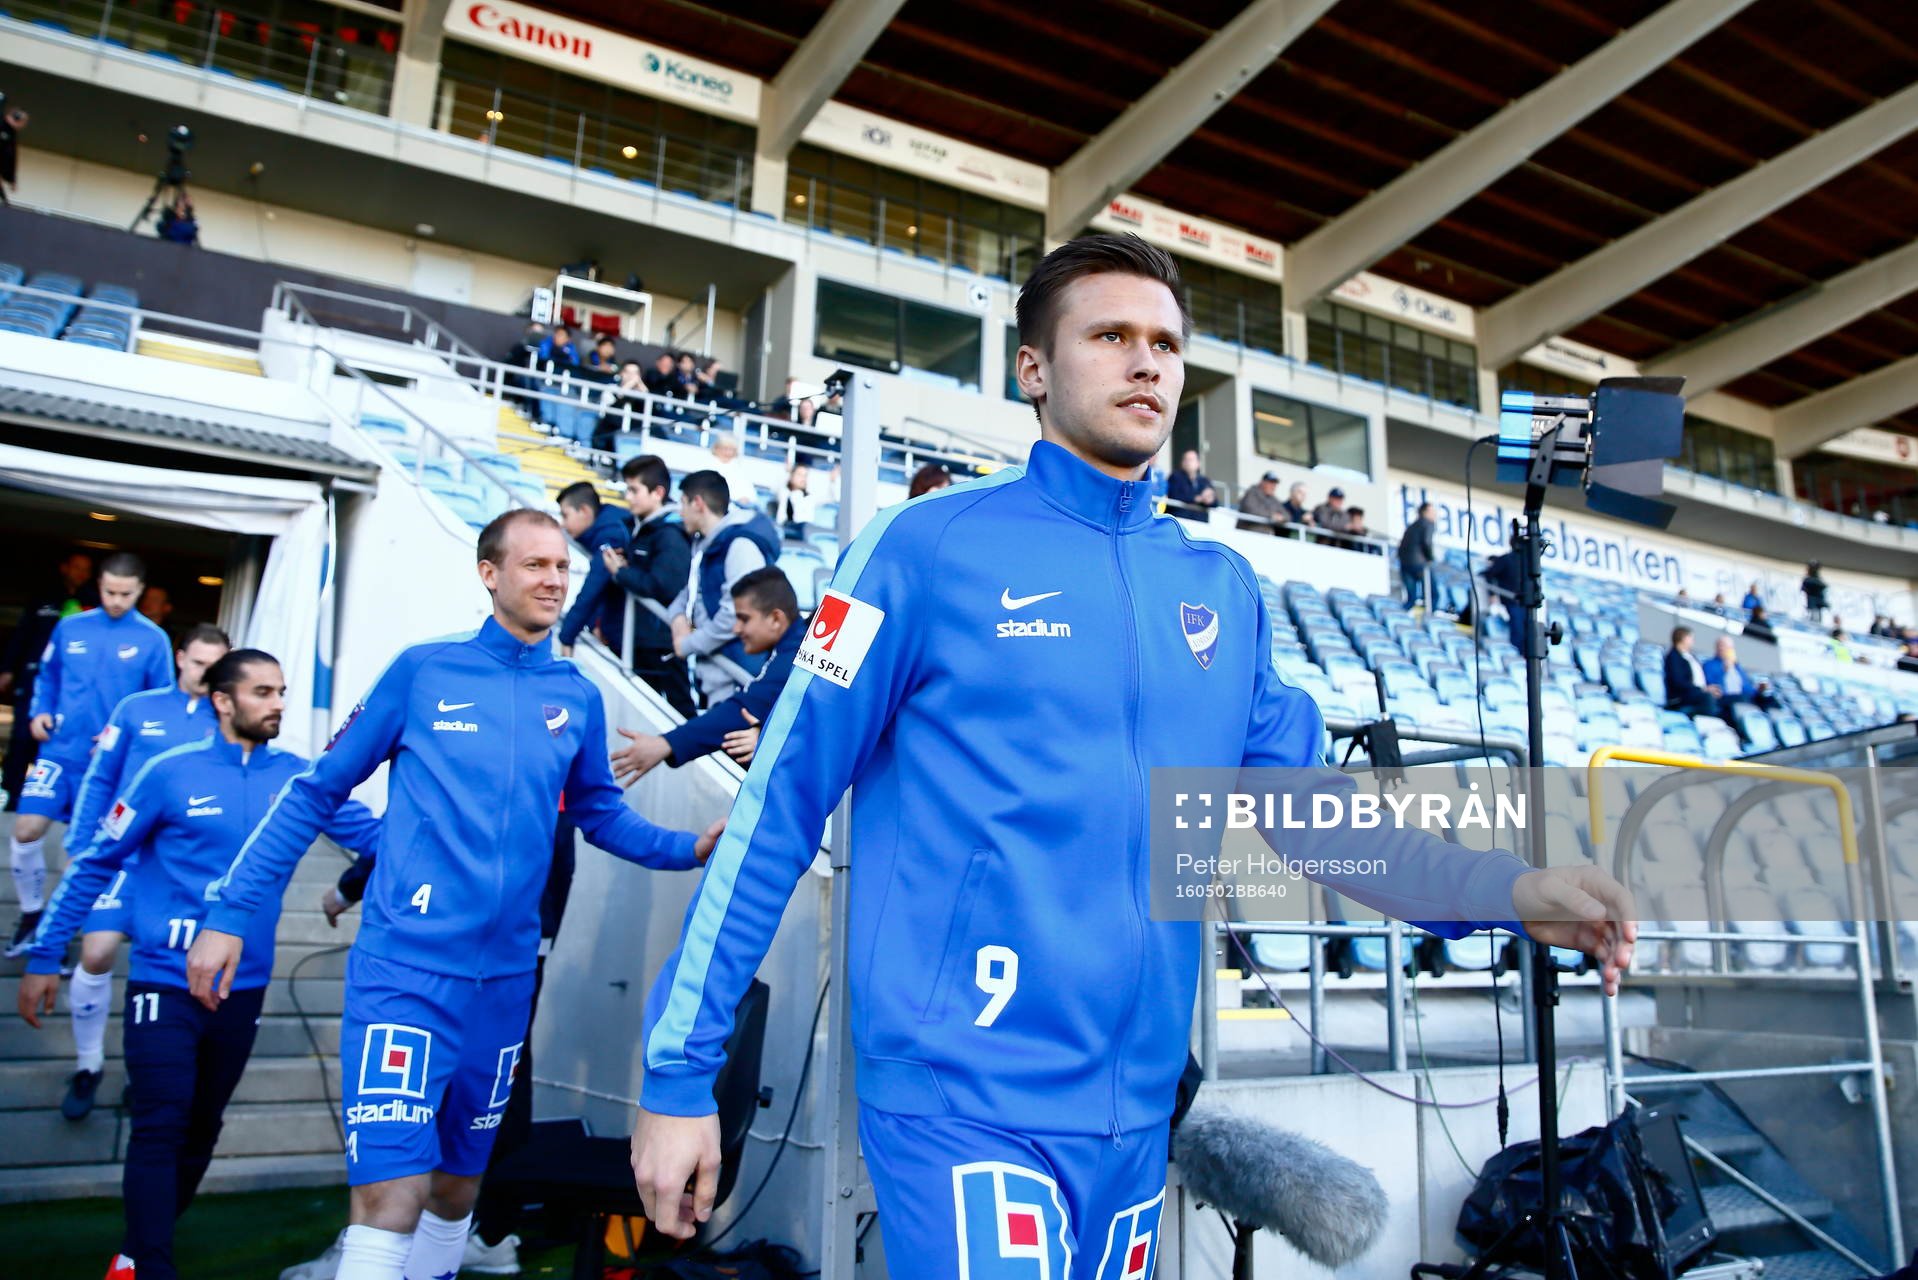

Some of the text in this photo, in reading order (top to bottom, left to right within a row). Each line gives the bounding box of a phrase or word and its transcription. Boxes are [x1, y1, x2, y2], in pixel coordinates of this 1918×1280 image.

[467, 3, 593, 60] Canon
[664, 59, 734, 97] Koneo
[1401, 483, 1685, 584] Handsbanken
[996, 618, 1072, 638] stadium
[1186, 612, 1206, 628] IFK
[817, 658, 848, 682] SPEL
[432, 719, 478, 733] stadium
[411, 883, 432, 914] 4
[168, 918, 197, 950] 11
[974, 944, 1019, 1027] 9
[132, 992, 160, 1025] 11
[346, 1099, 434, 1126] stadium
[470, 1111, 504, 1130] sta
